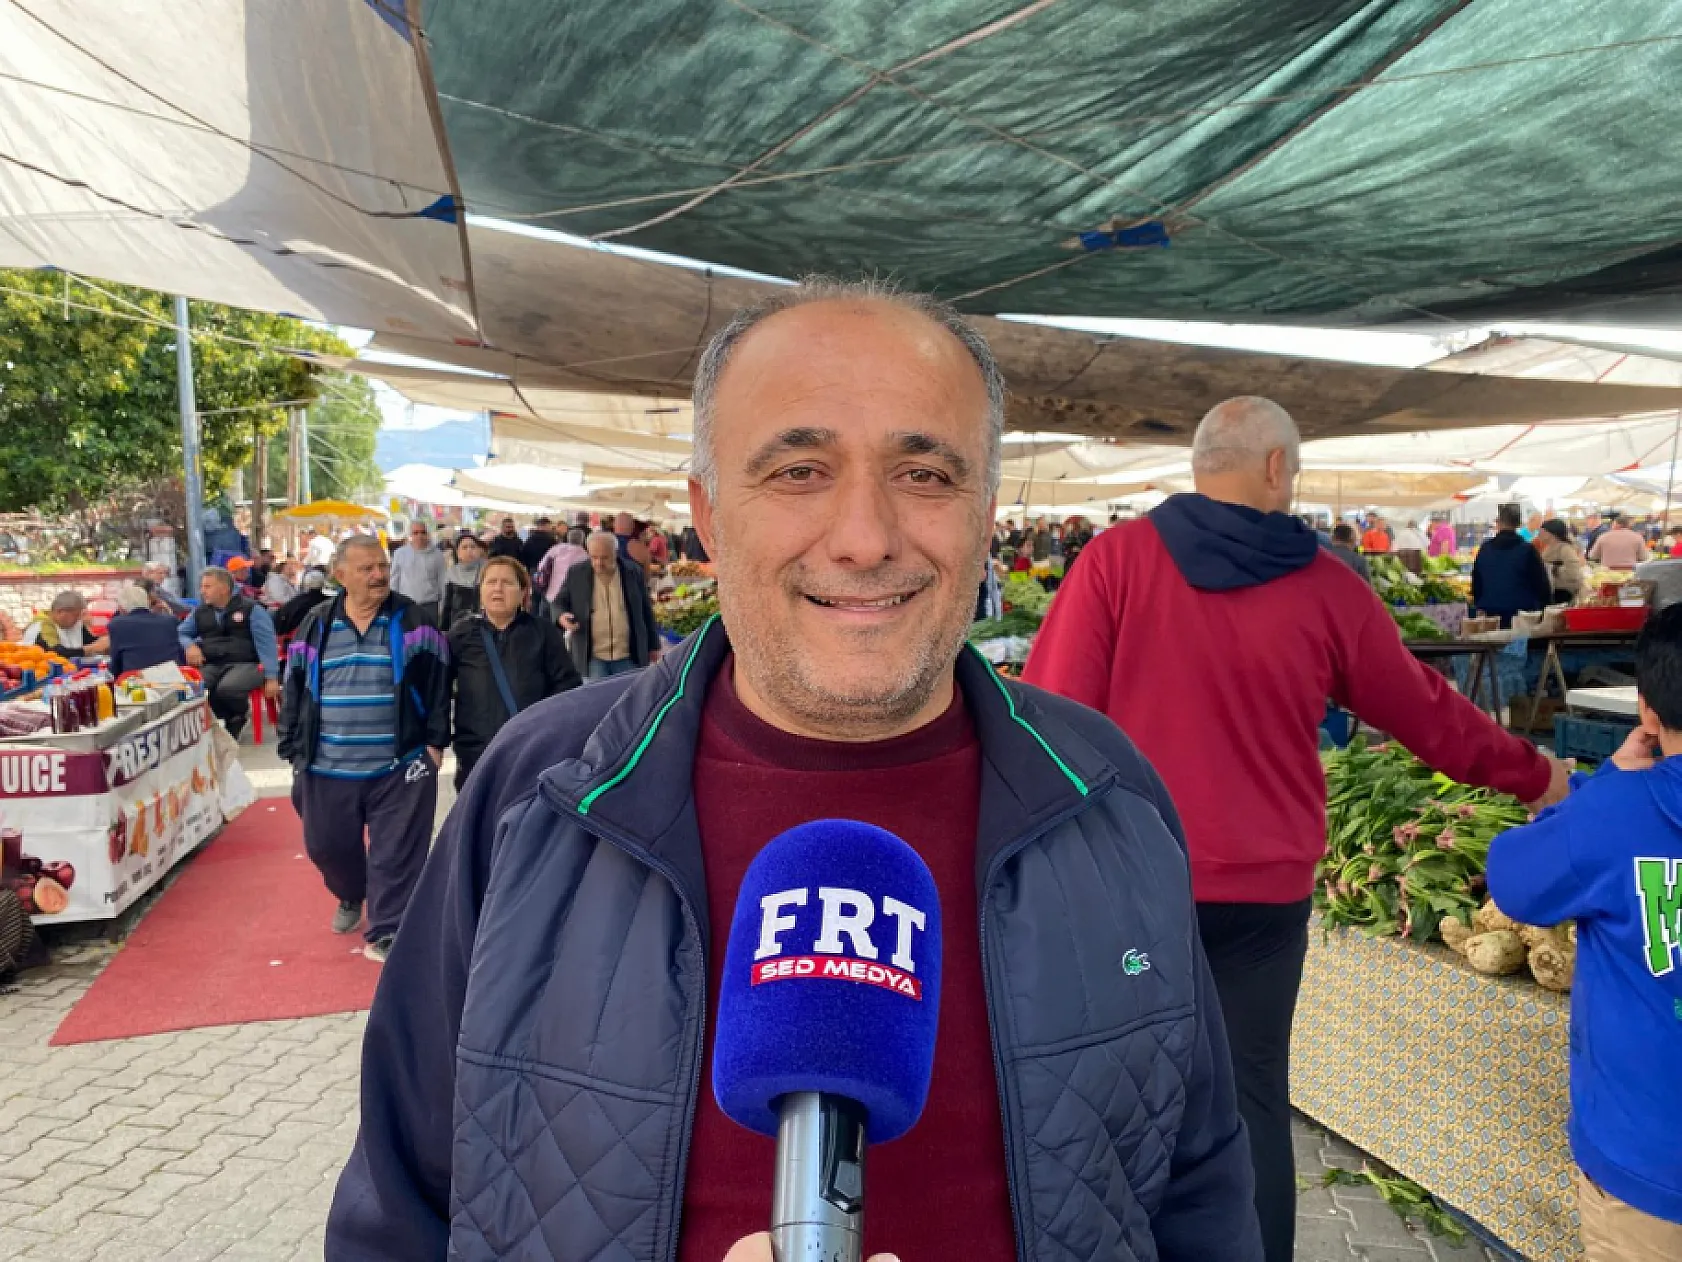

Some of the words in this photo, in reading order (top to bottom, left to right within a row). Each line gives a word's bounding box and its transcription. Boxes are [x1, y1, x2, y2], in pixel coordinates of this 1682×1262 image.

[754, 886, 926, 974] FRT
[760, 959, 815, 980] SED
[823, 960, 916, 997] MEDYA
